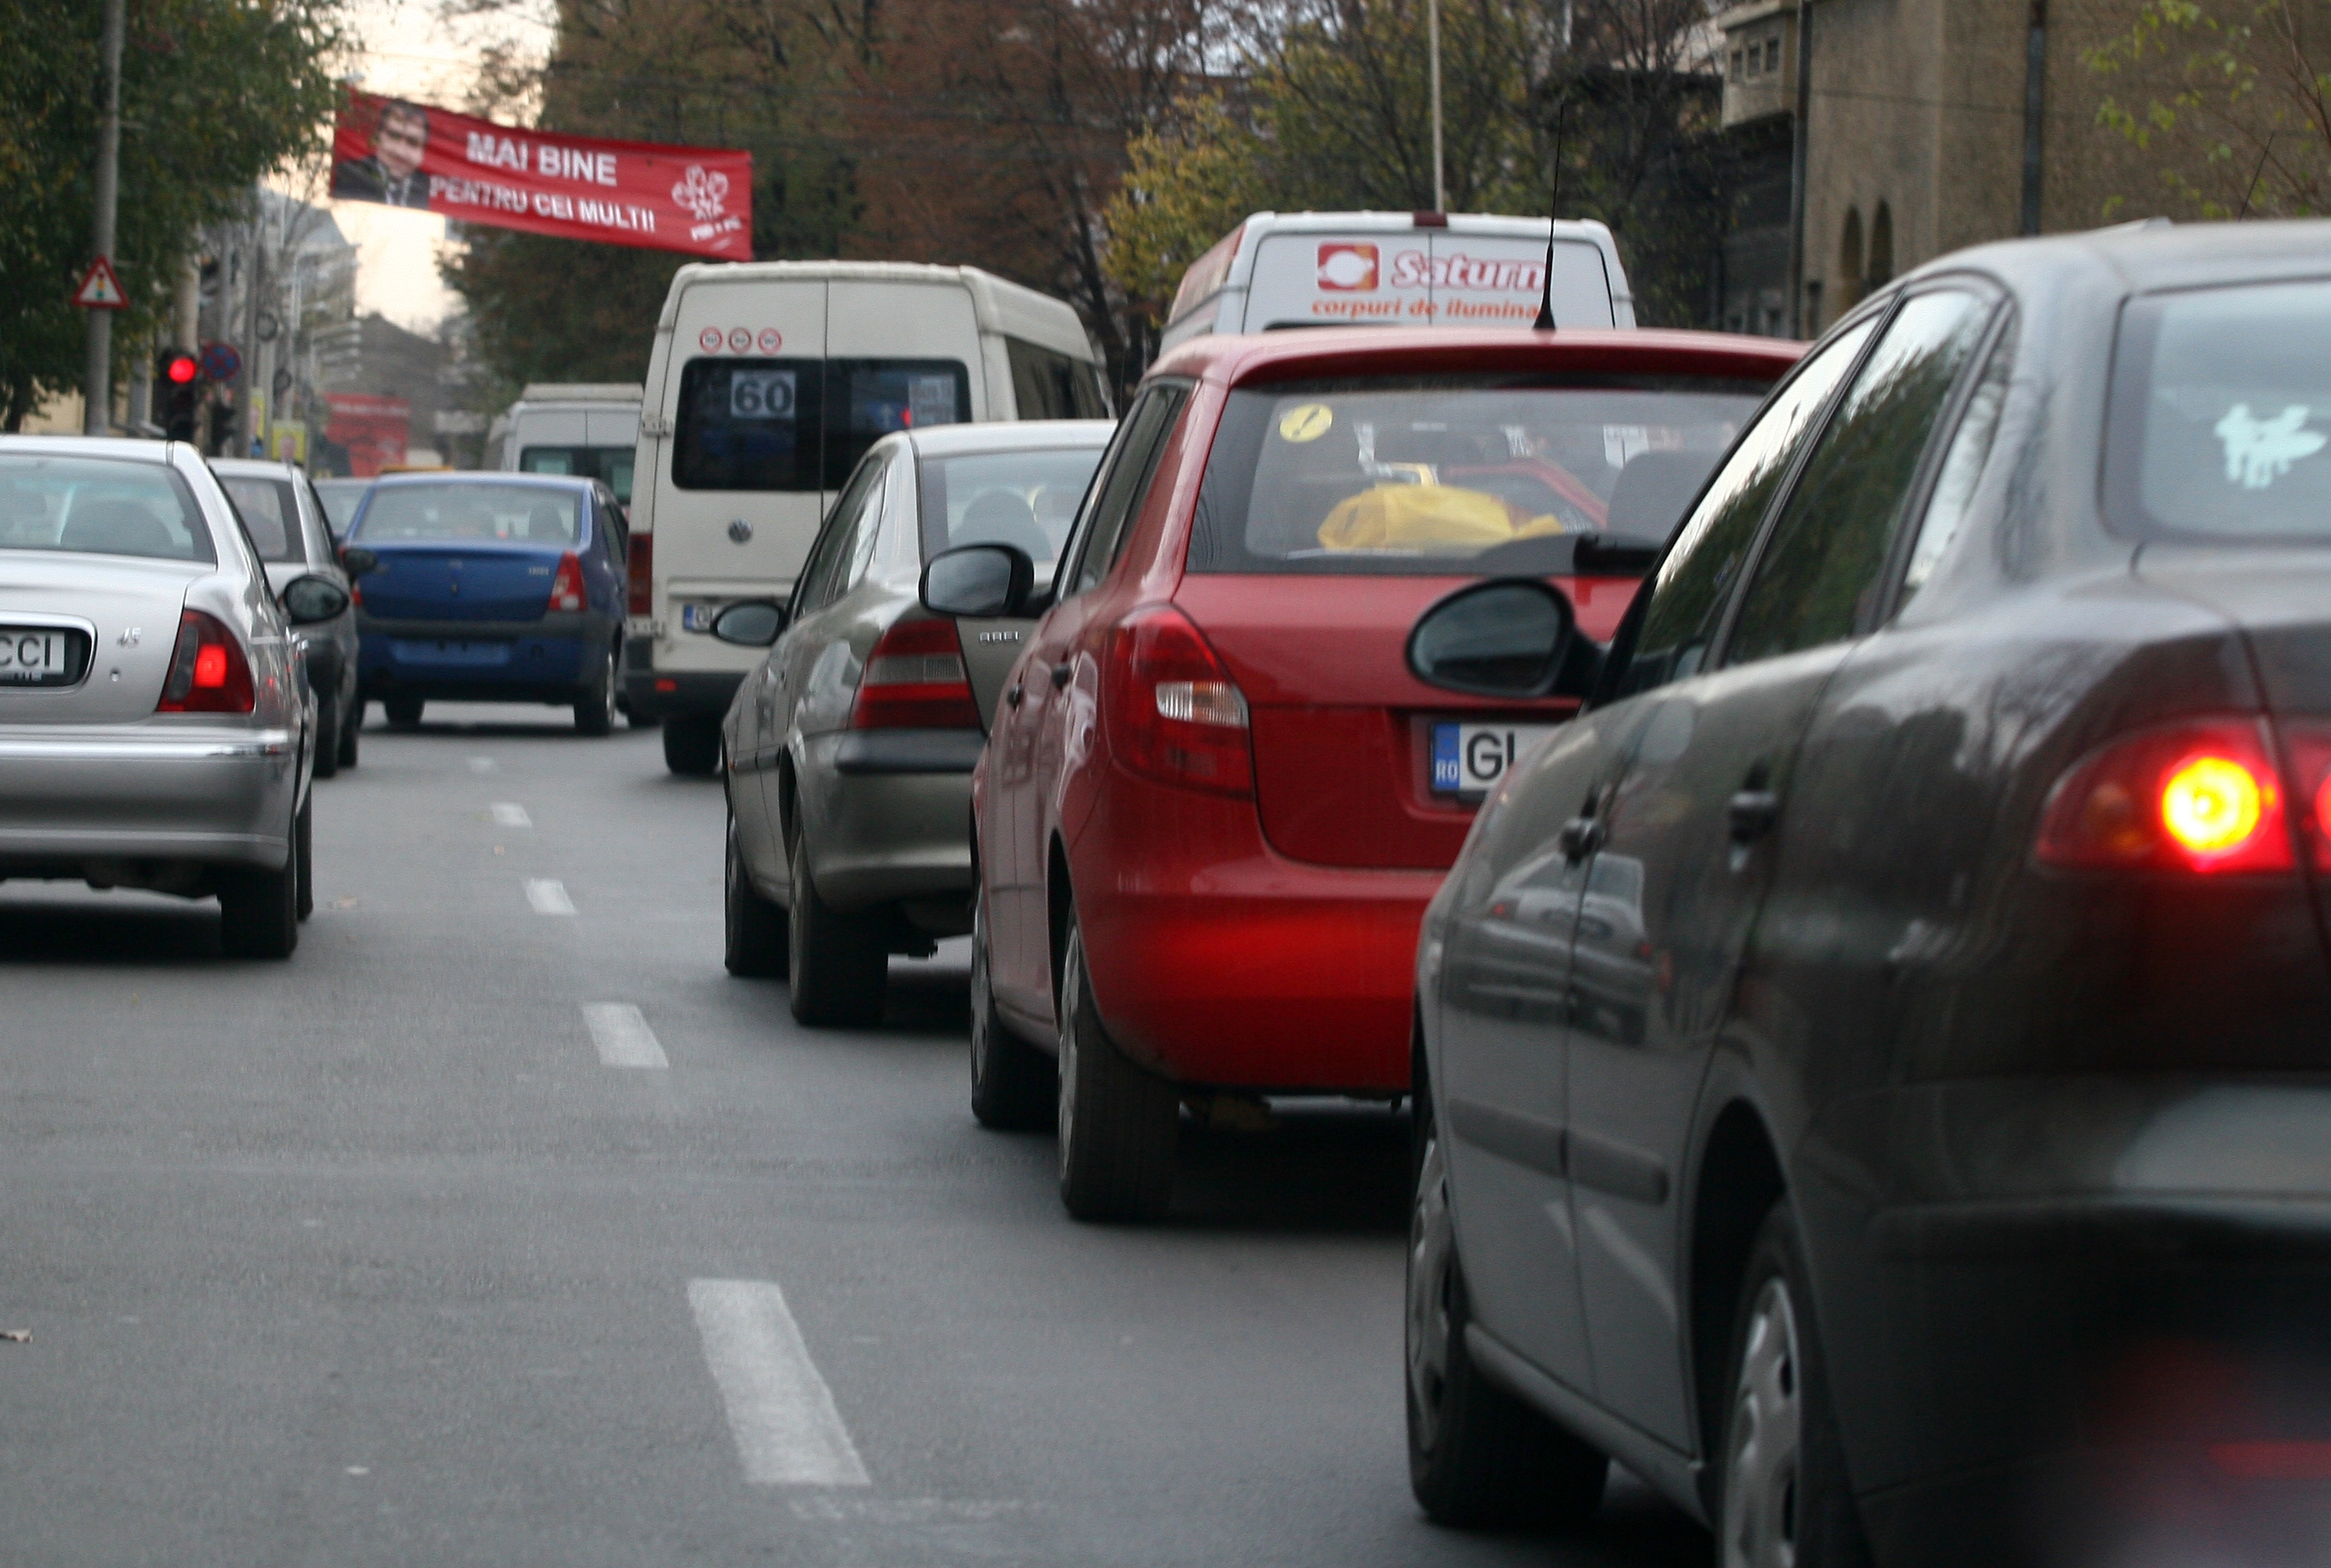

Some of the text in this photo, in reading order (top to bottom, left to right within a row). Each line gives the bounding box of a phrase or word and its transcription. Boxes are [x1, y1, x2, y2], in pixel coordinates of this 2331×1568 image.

[466, 131, 618, 187] MAI BINE
[430, 173, 529, 214] PENTRU
[534, 193, 574, 221] CEI
[1391, 250, 1545, 292] Saturn
[1311, 297, 1403, 319] corpuri
[1409, 299, 1439, 318] de
[735, 379, 794, 414] 60
[1436, 759, 1458, 782] RO
